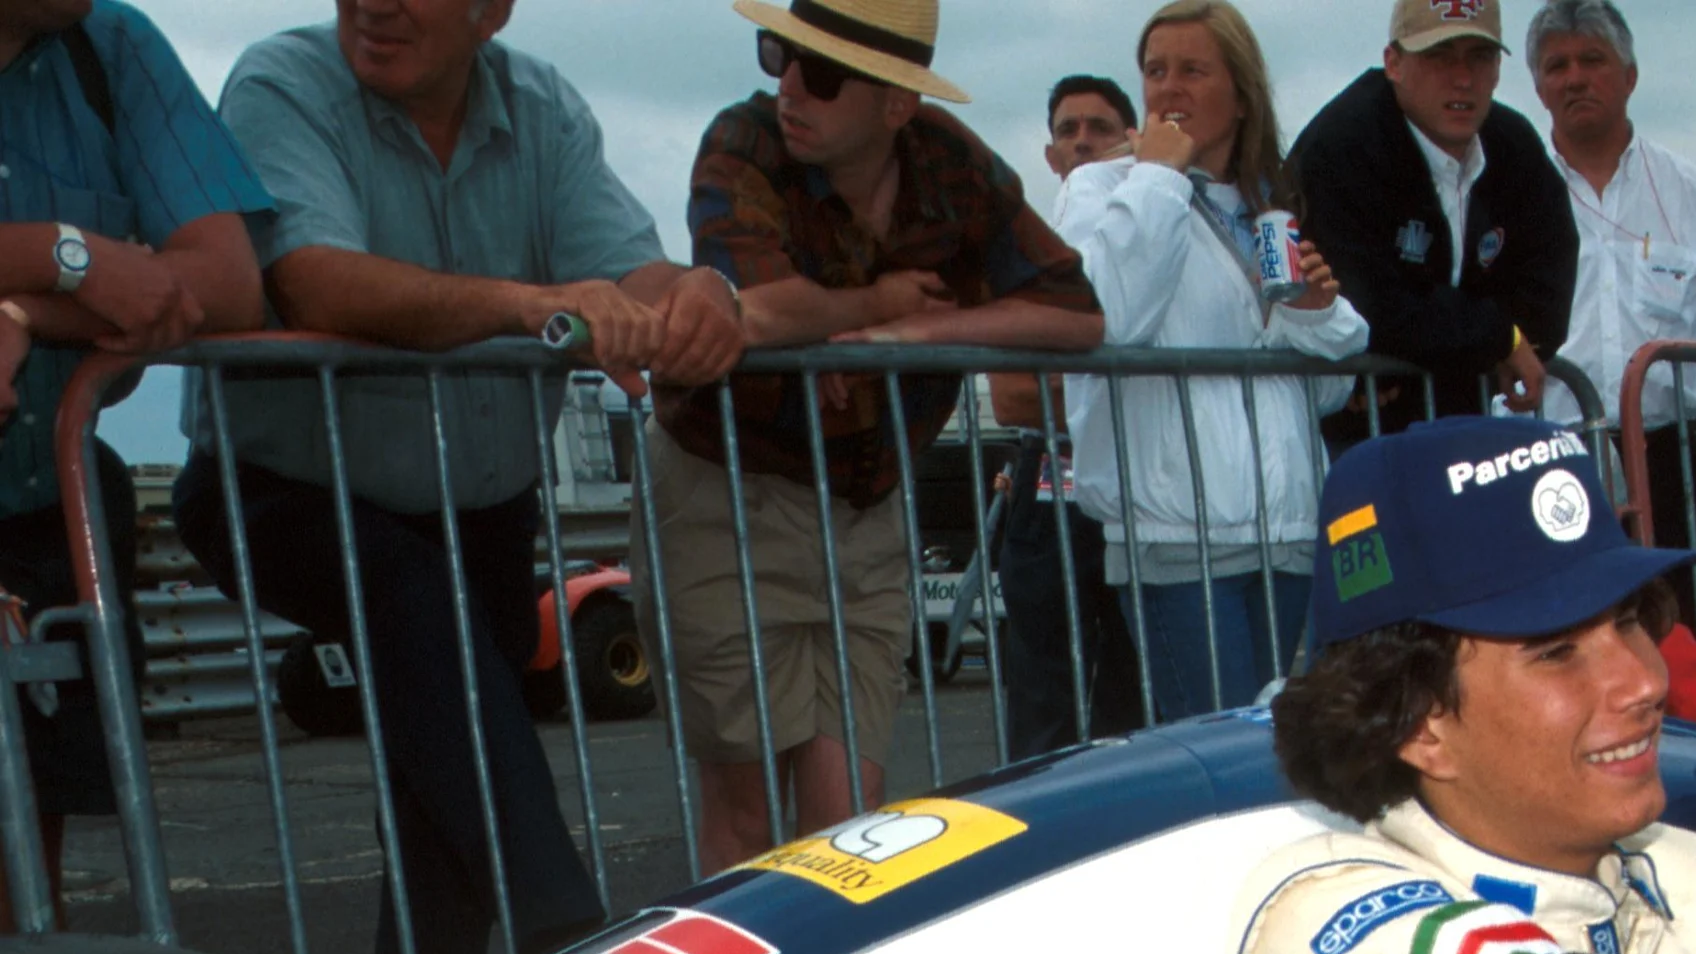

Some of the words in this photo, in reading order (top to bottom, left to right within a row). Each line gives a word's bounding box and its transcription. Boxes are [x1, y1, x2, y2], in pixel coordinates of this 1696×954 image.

[1262, 222, 1280, 279] PEPSI
[1338, 539, 1379, 578] BR
[1319, 883, 1443, 954] sparco
